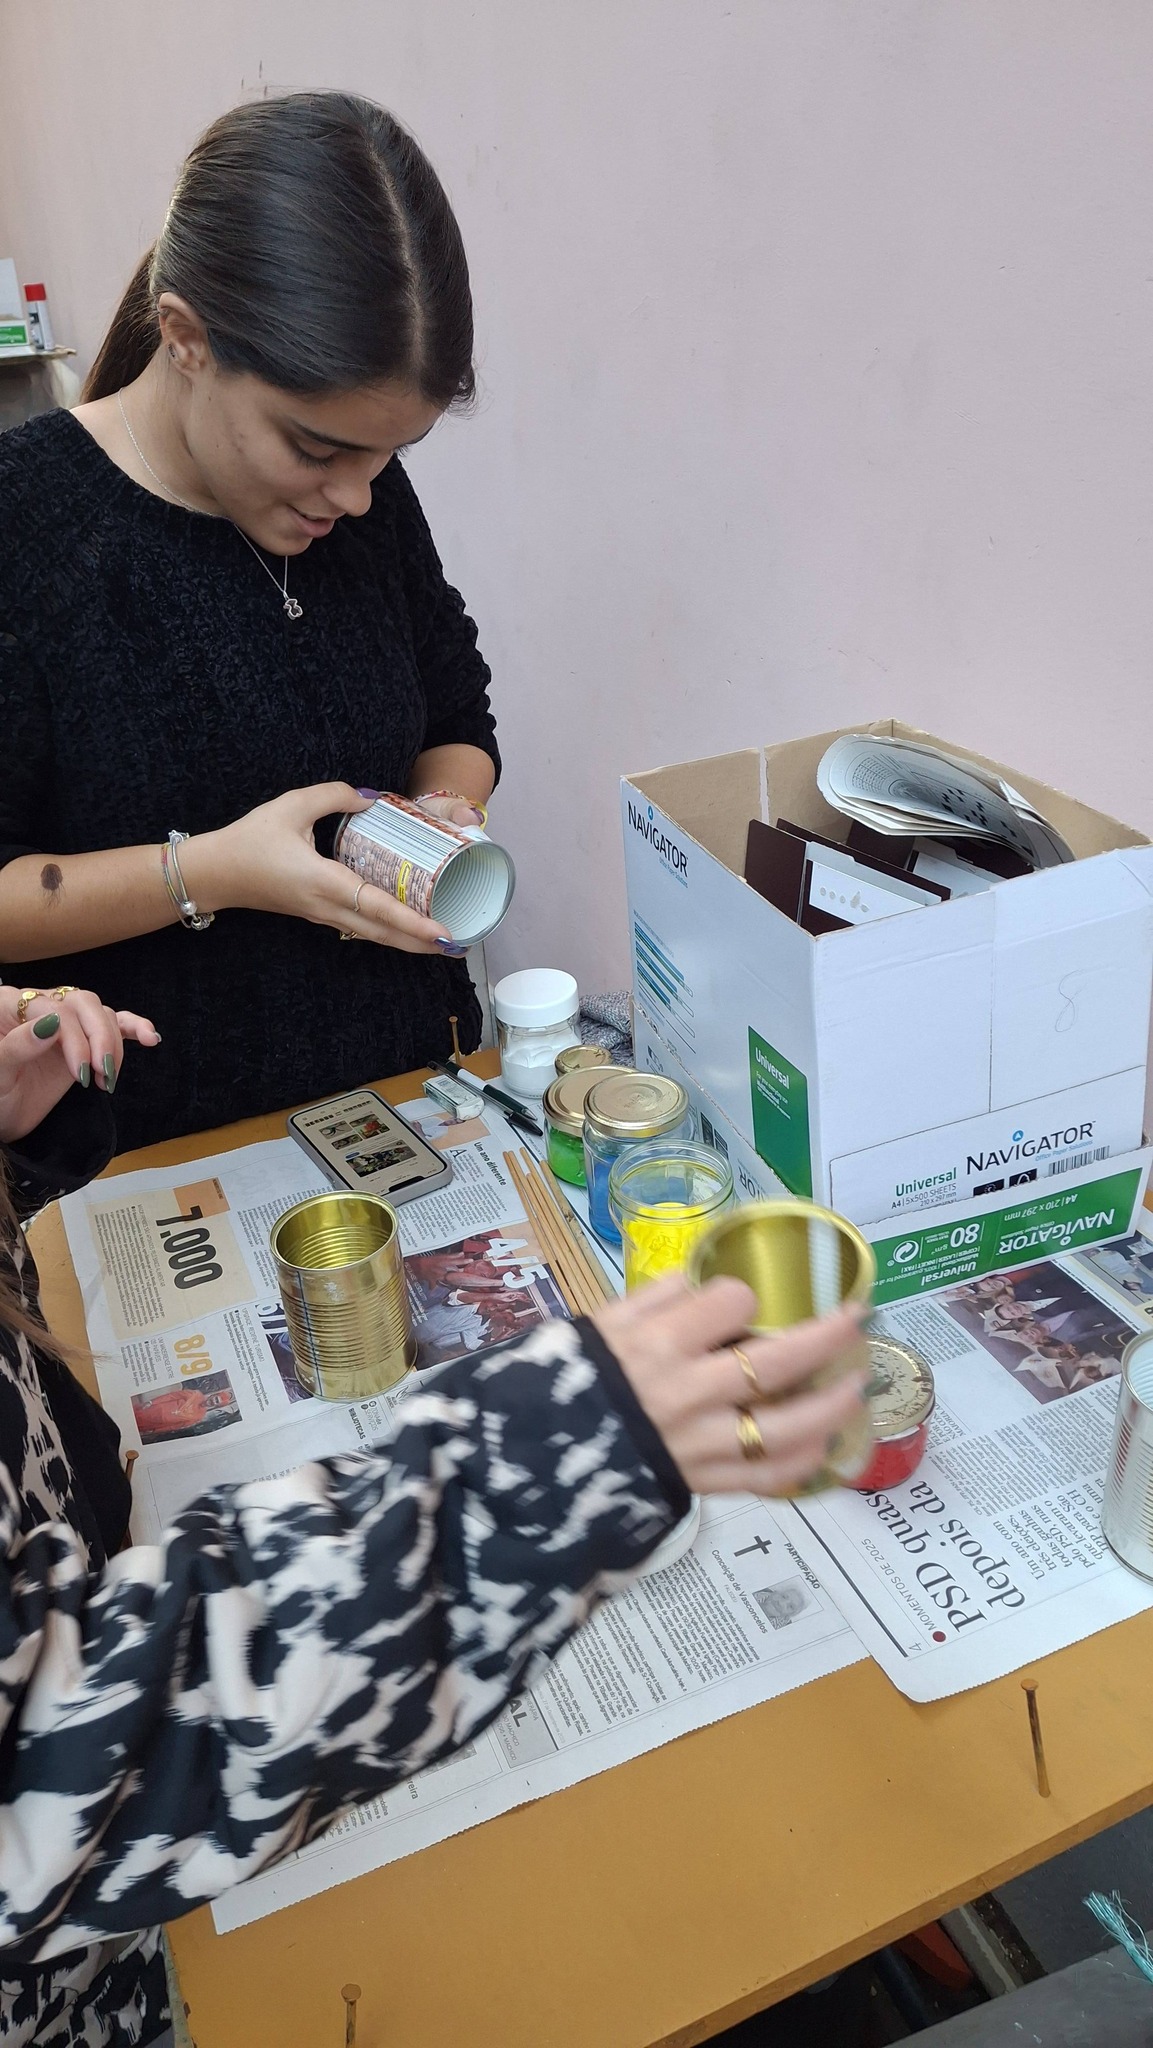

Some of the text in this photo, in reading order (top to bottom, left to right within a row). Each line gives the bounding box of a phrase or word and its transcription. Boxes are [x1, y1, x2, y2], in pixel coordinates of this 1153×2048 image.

[628, 800, 688, 877] NAVIGATOR
[756, 1047, 789, 1089] Universal
[479, 1151, 489, 1161] ano
[486, 1161, 506, 1185] diferente
[966, 1121, 1093, 1175] NAVIGATOR
[896, 1167, 956, 1196] Universal
[157, 1206, 221, 1288] 7.000
[950, 1223, 979, 1247] 80
[999, 1209, 1113, 1253] NAVIGATOR
[482, 1237, 550, 1289] 4/5
[921, 1261, 976, 1285] Universal
[174, 1334, 213, 1376] 8/9
[348, 1407, 365, 1439] BIBLIOTECAS
[940, 1410, 965, 1436] MAIORIA
[909, 1481, 944, 1513] da
[1053, 1493, 1076, 1513] São
[1066, 1489, 1086, 1505] CH
[1082, 1483, 1103, 1503] uma
[1018, 1510, 1072, 1567] todas ganhas
[1030, 1504, 1095, 1568] pelo PSD, mas
[1051, 1507, 1086, 1543] levaram
[1071, 1509, 1097, 1532] para
[940, 1519, 1024, 1606] depois
[992, 1520, 1044, 1579] Um ano com
[1007, 1514, 1056, 1570] três eleições,
[1083, 1542, 1103, 1559] que
[784, 1543, 820, 1590] PARTICIPAÇÃO
[861, 1538, 936, 1630] MOMENTOS DE 2025
[711, 1549, 767, 1633] Conceição de Vasconcelos
[915, 1562, 988, 1634] PSD
[908, 1642, 921, 1650] 4
